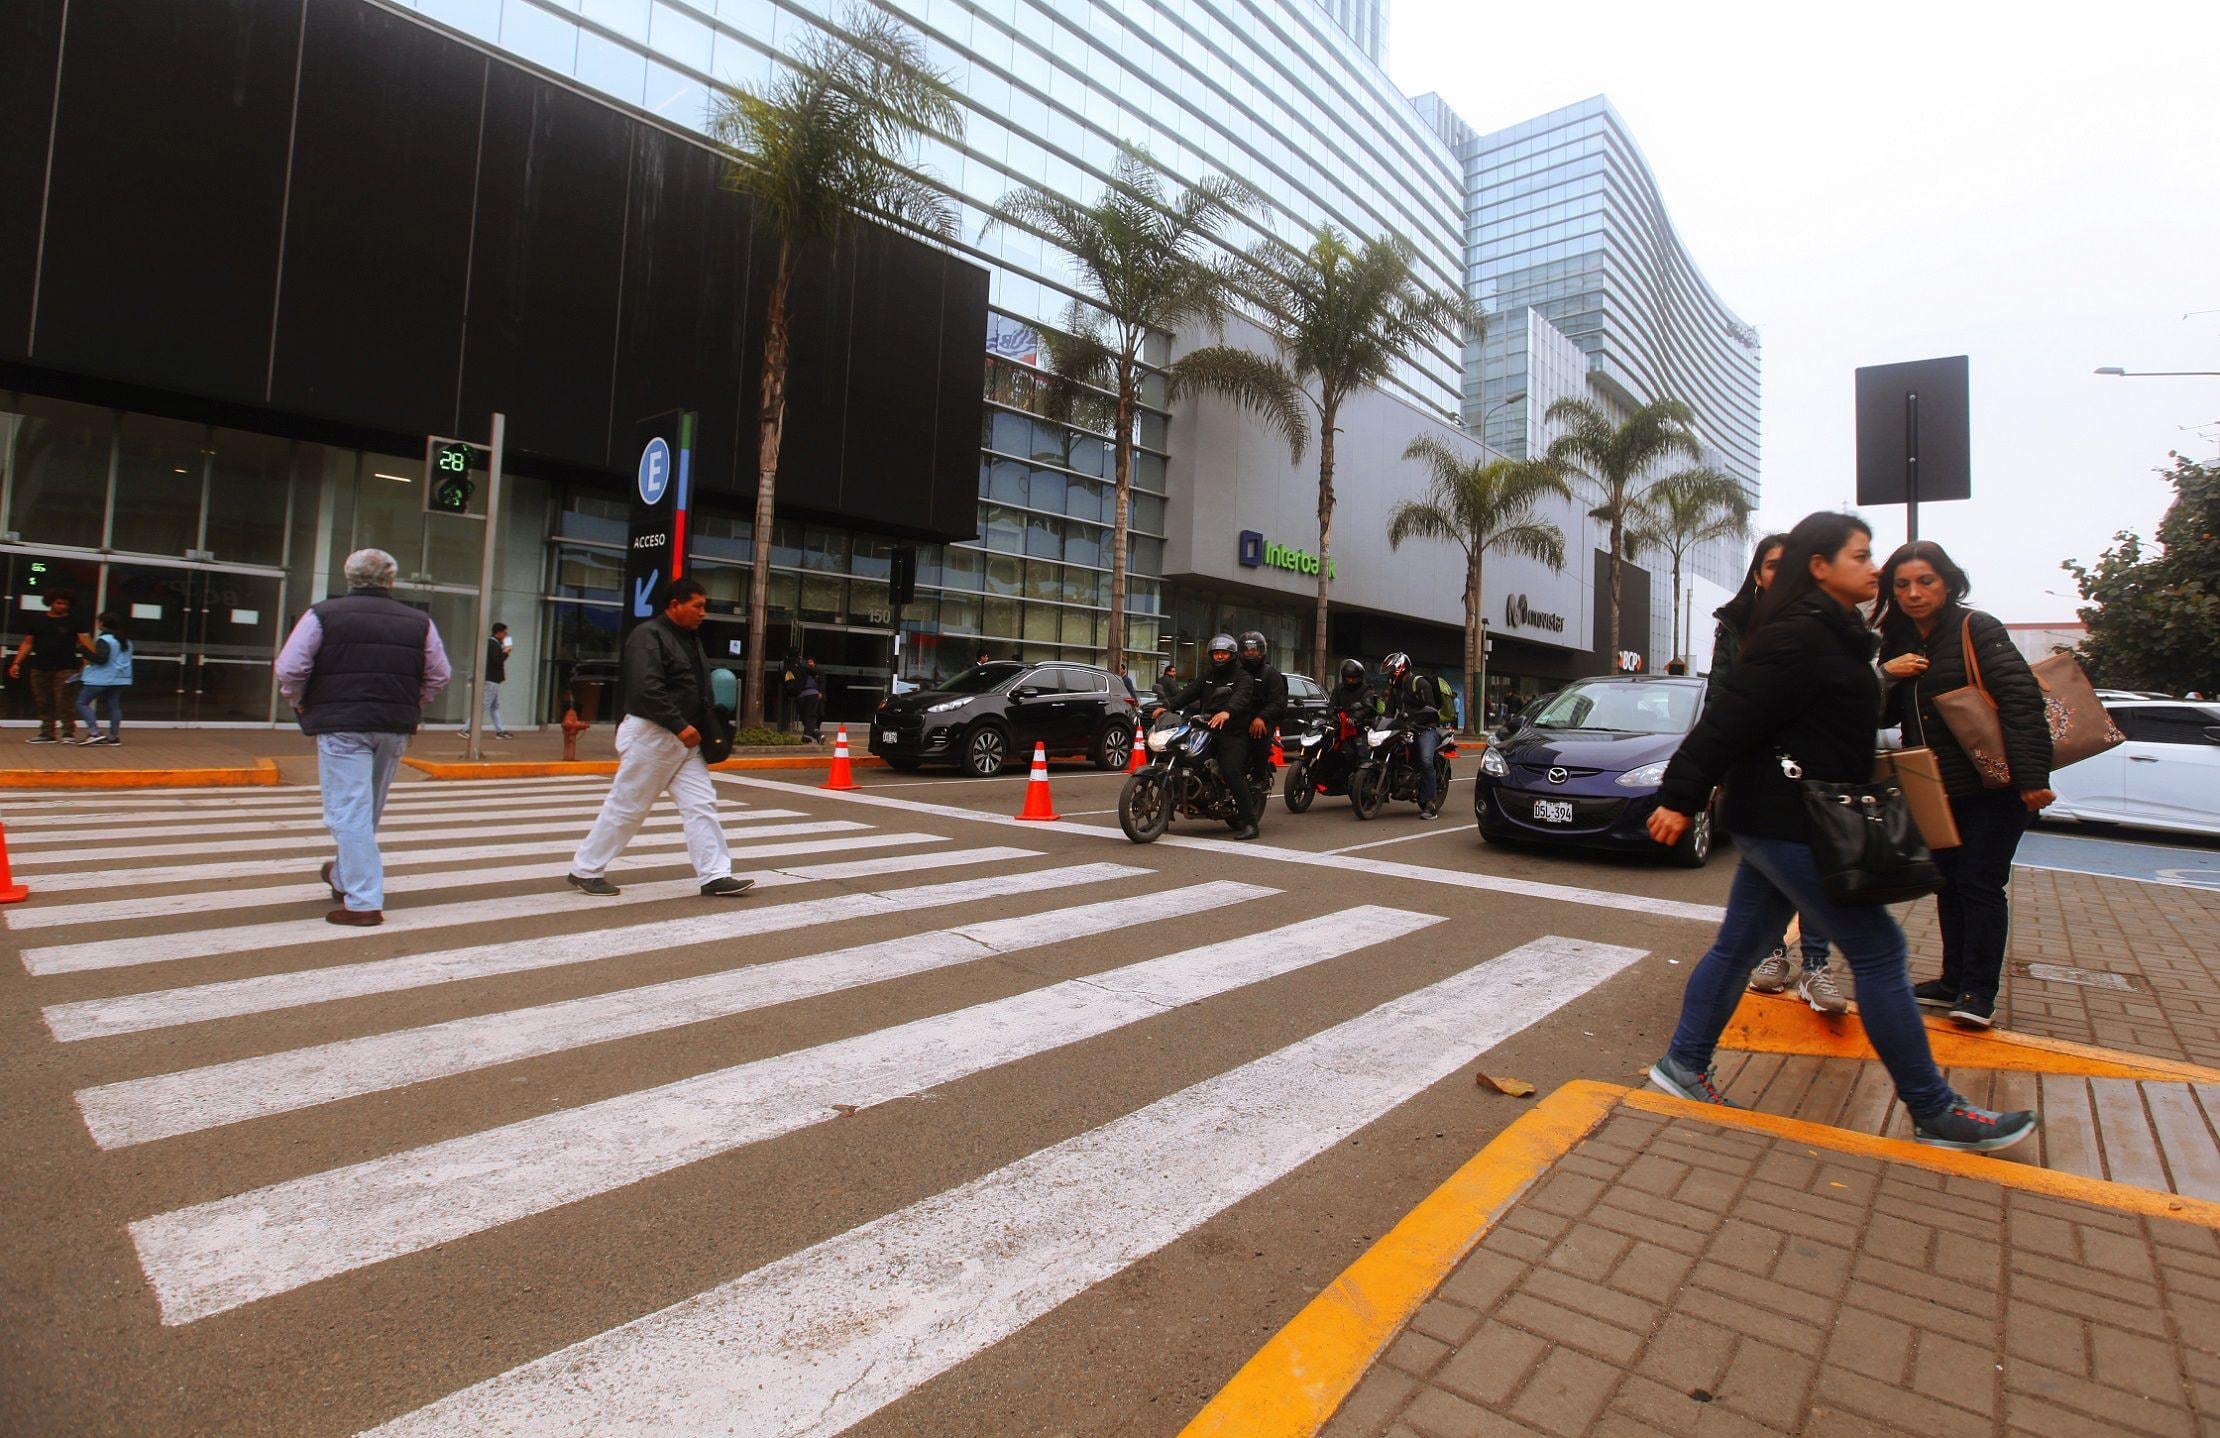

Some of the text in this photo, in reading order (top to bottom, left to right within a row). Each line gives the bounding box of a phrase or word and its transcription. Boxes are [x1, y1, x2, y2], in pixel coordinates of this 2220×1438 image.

[440, 450, 464, 471] 28
[648, 451, 662, 492] E
[633, 533, 666, 549] ACCESO
[1263, 540, 1337, 580] Interbak
[867, 607, 891, 624] 150
[1527, 609, 1565, 633] movistar
[1623, 650, 1638, 671] BCP
